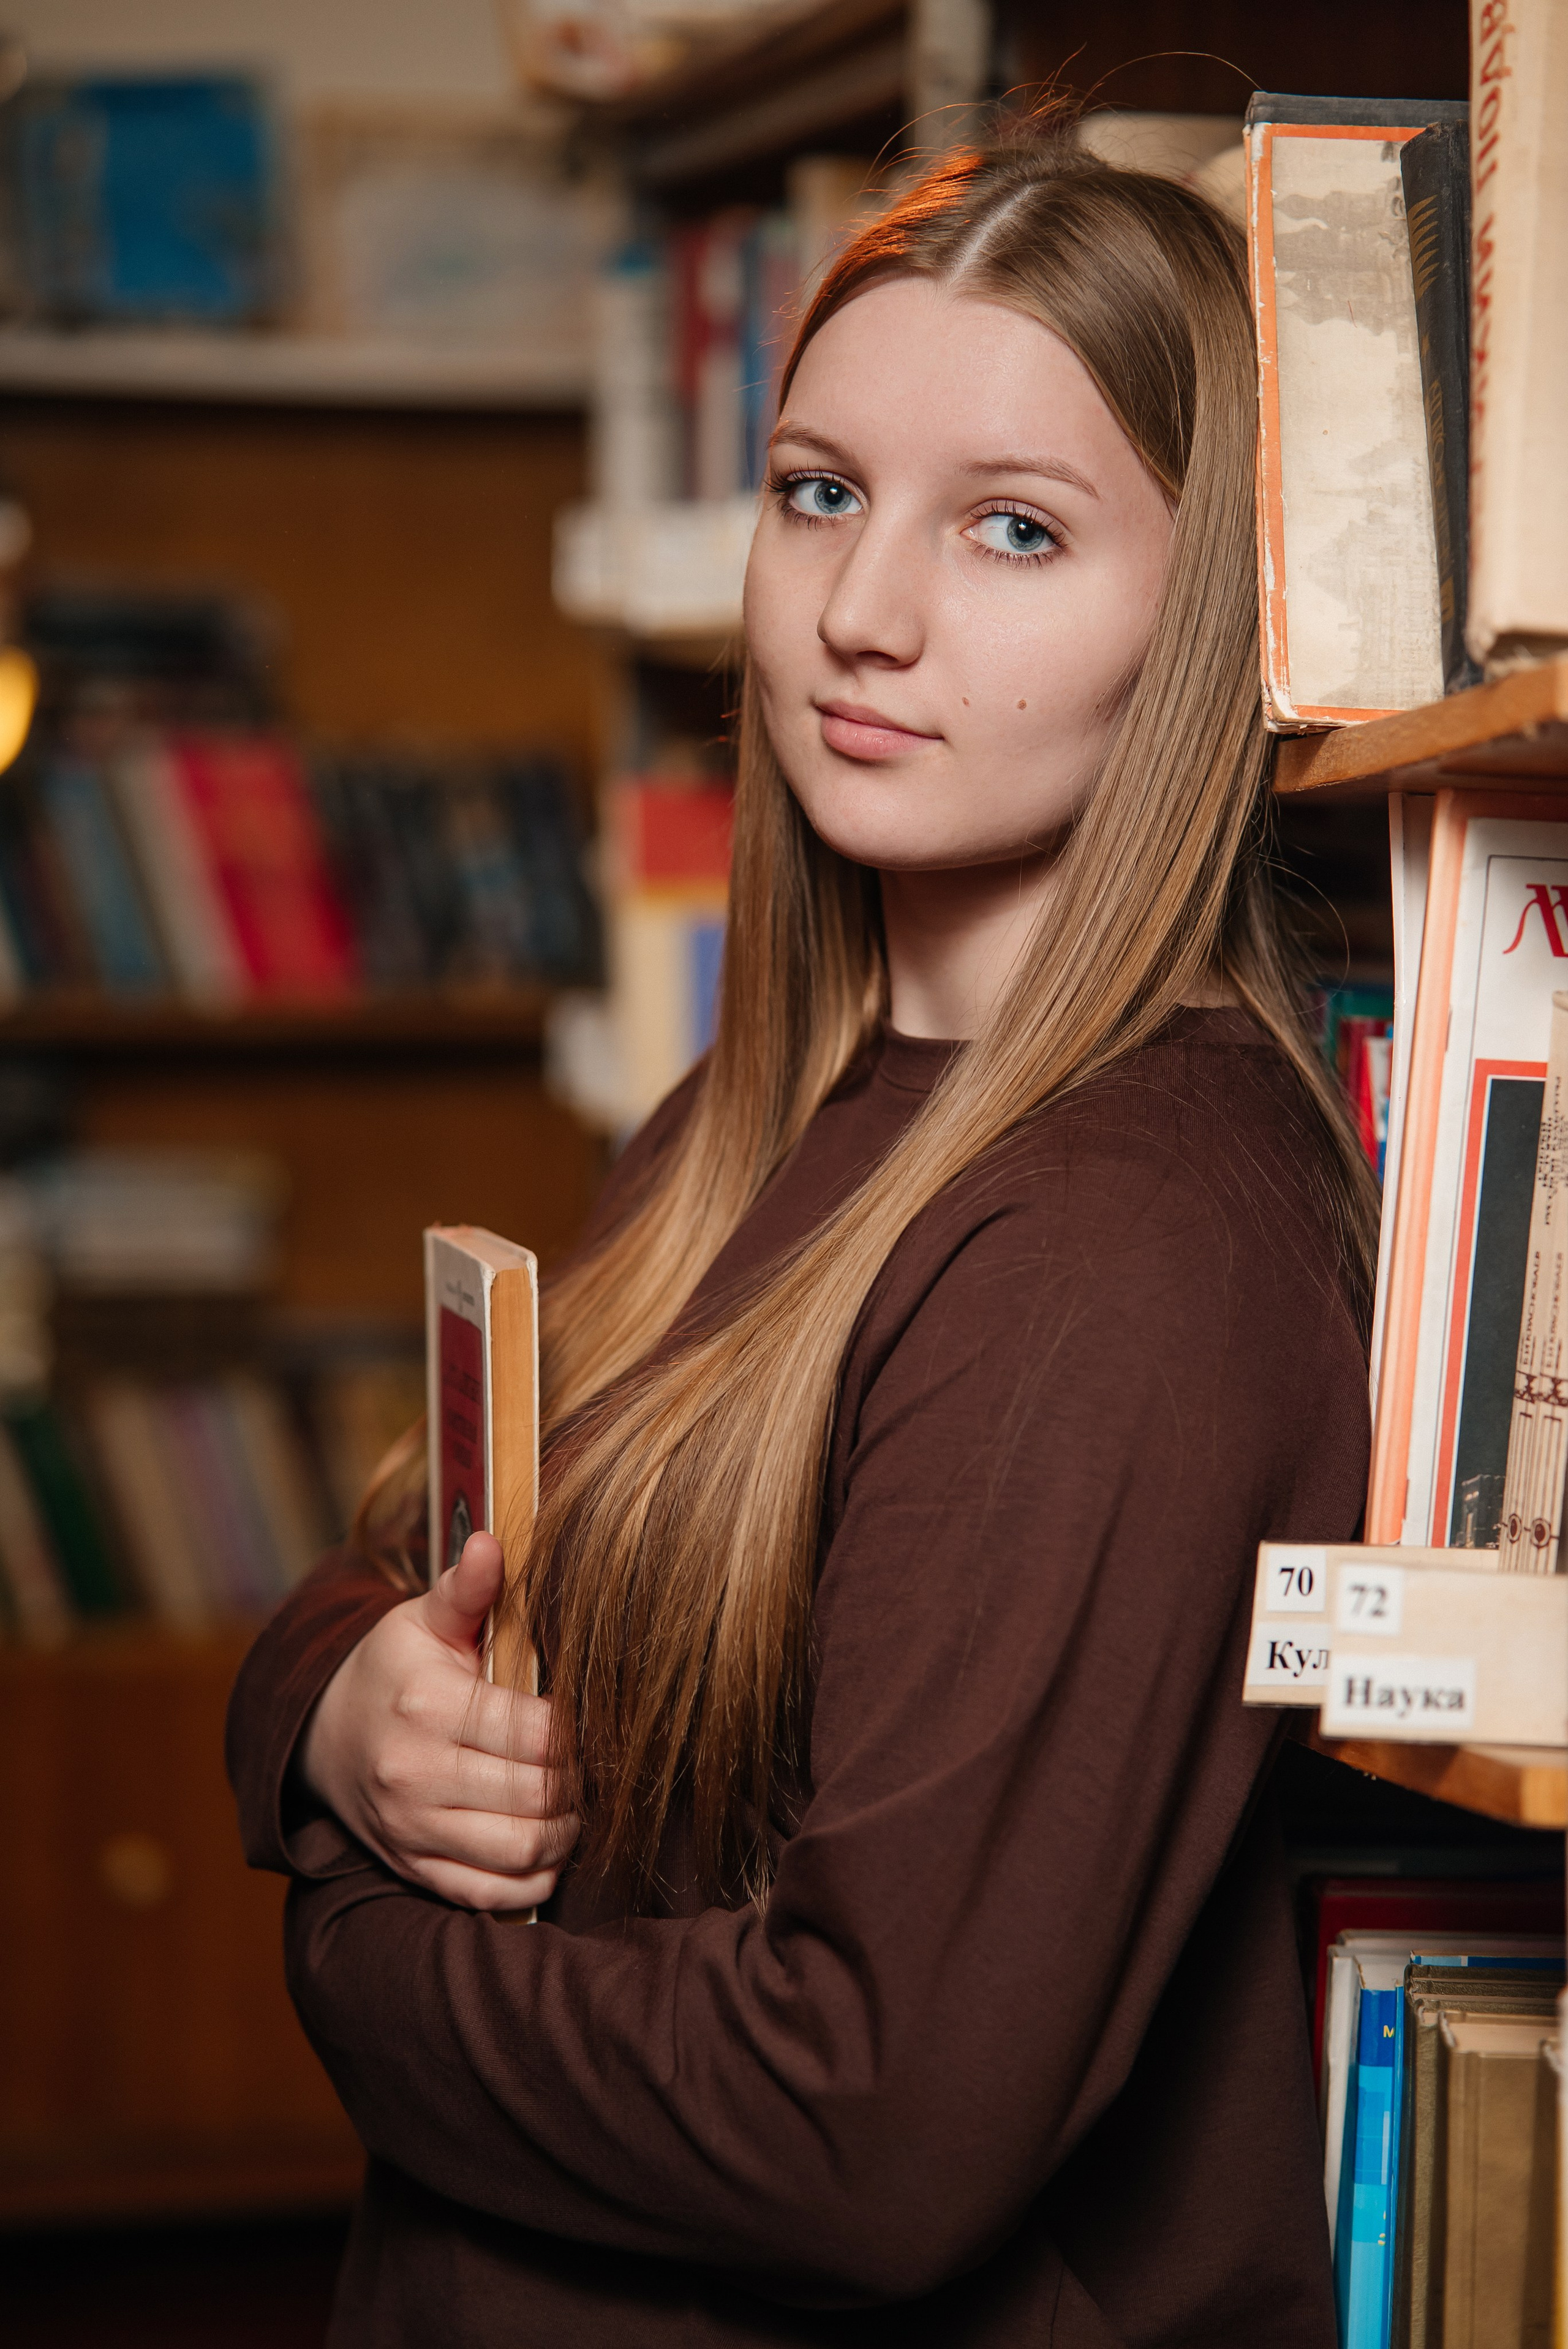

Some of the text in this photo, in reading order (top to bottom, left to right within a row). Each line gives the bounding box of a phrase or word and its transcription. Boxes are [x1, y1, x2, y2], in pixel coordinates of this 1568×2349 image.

[1279, 1566, 1314, 1597] 70
[1348, 1582, 1387, 1618] 72
[1265, 1640, 1330, 1678] Кул
[1344, 1676, 1465, 1719] Наука
